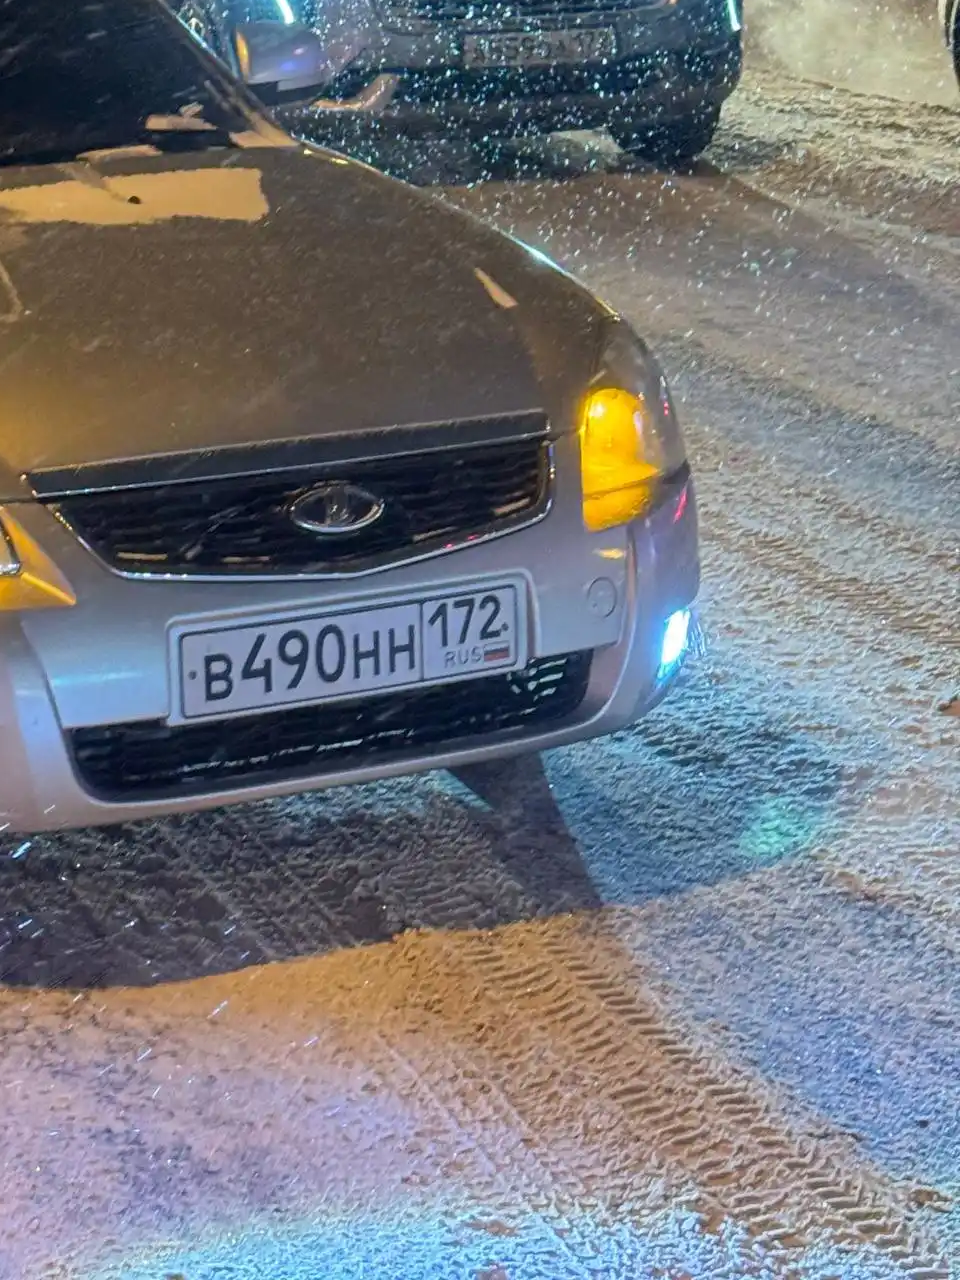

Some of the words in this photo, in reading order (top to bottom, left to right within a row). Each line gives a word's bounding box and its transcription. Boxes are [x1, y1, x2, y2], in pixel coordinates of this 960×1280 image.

[203, 624, 416, 702] В490НН
[427, 595, 503, 648] 172
[443, 650, 482, 669] RUS
